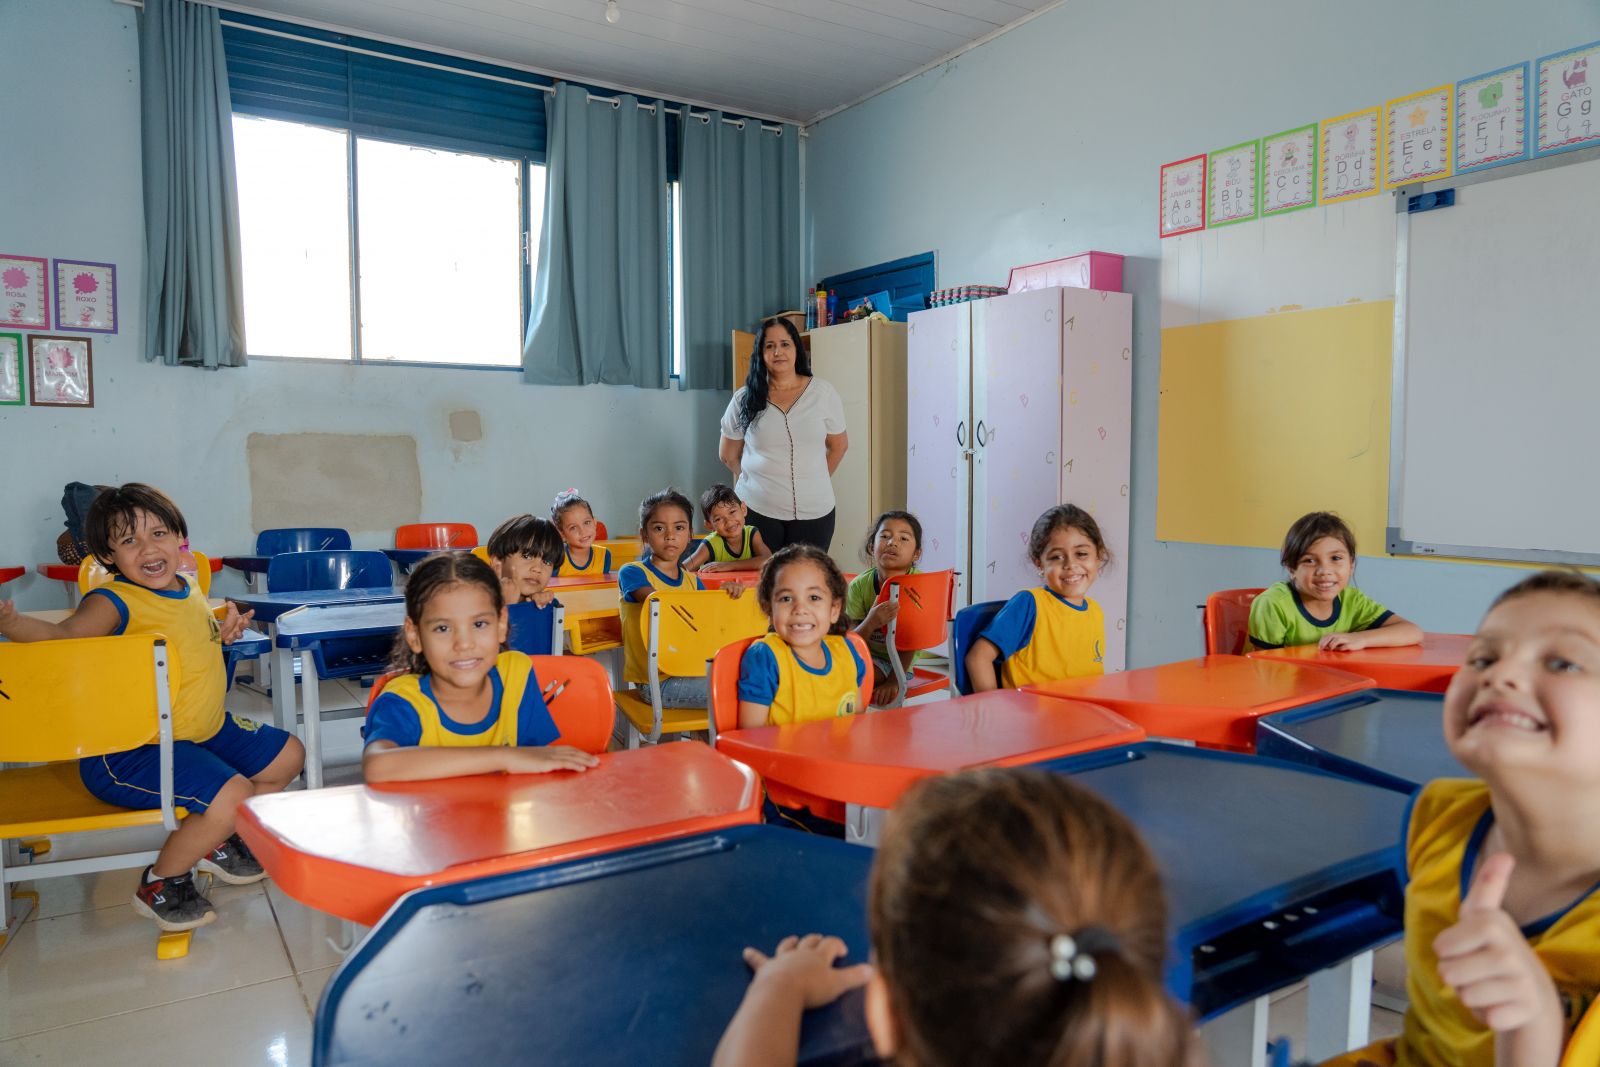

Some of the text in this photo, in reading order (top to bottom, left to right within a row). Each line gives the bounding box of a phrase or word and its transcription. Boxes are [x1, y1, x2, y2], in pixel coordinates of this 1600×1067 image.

[1561, 86, 1592, 101] GATO
[1557, 100, 1592, 117] G g
[1400, 126, 1437, 141] ESTRELA
[1476, 116, 1506, 137] F f
[1402, 139, 1433, 156] E e
[1337, 157, 1363, 174] D d
[1225, 178, 1241, 188] BIDU
[1276, 176, 1287, 188] C
[1170, 188, 1195, 199] ARANHA
[1221, 187, 1243, 202] B b
[1172, 200, 1192, 212] A a
[5, 290, 27, 298] ROSA
[75, 295, 97, 303] ROXO
[1065, 316, 1075, 331] A
[1122, 348, 1130, 361] C
[1098, 426, 1107, 440] B
